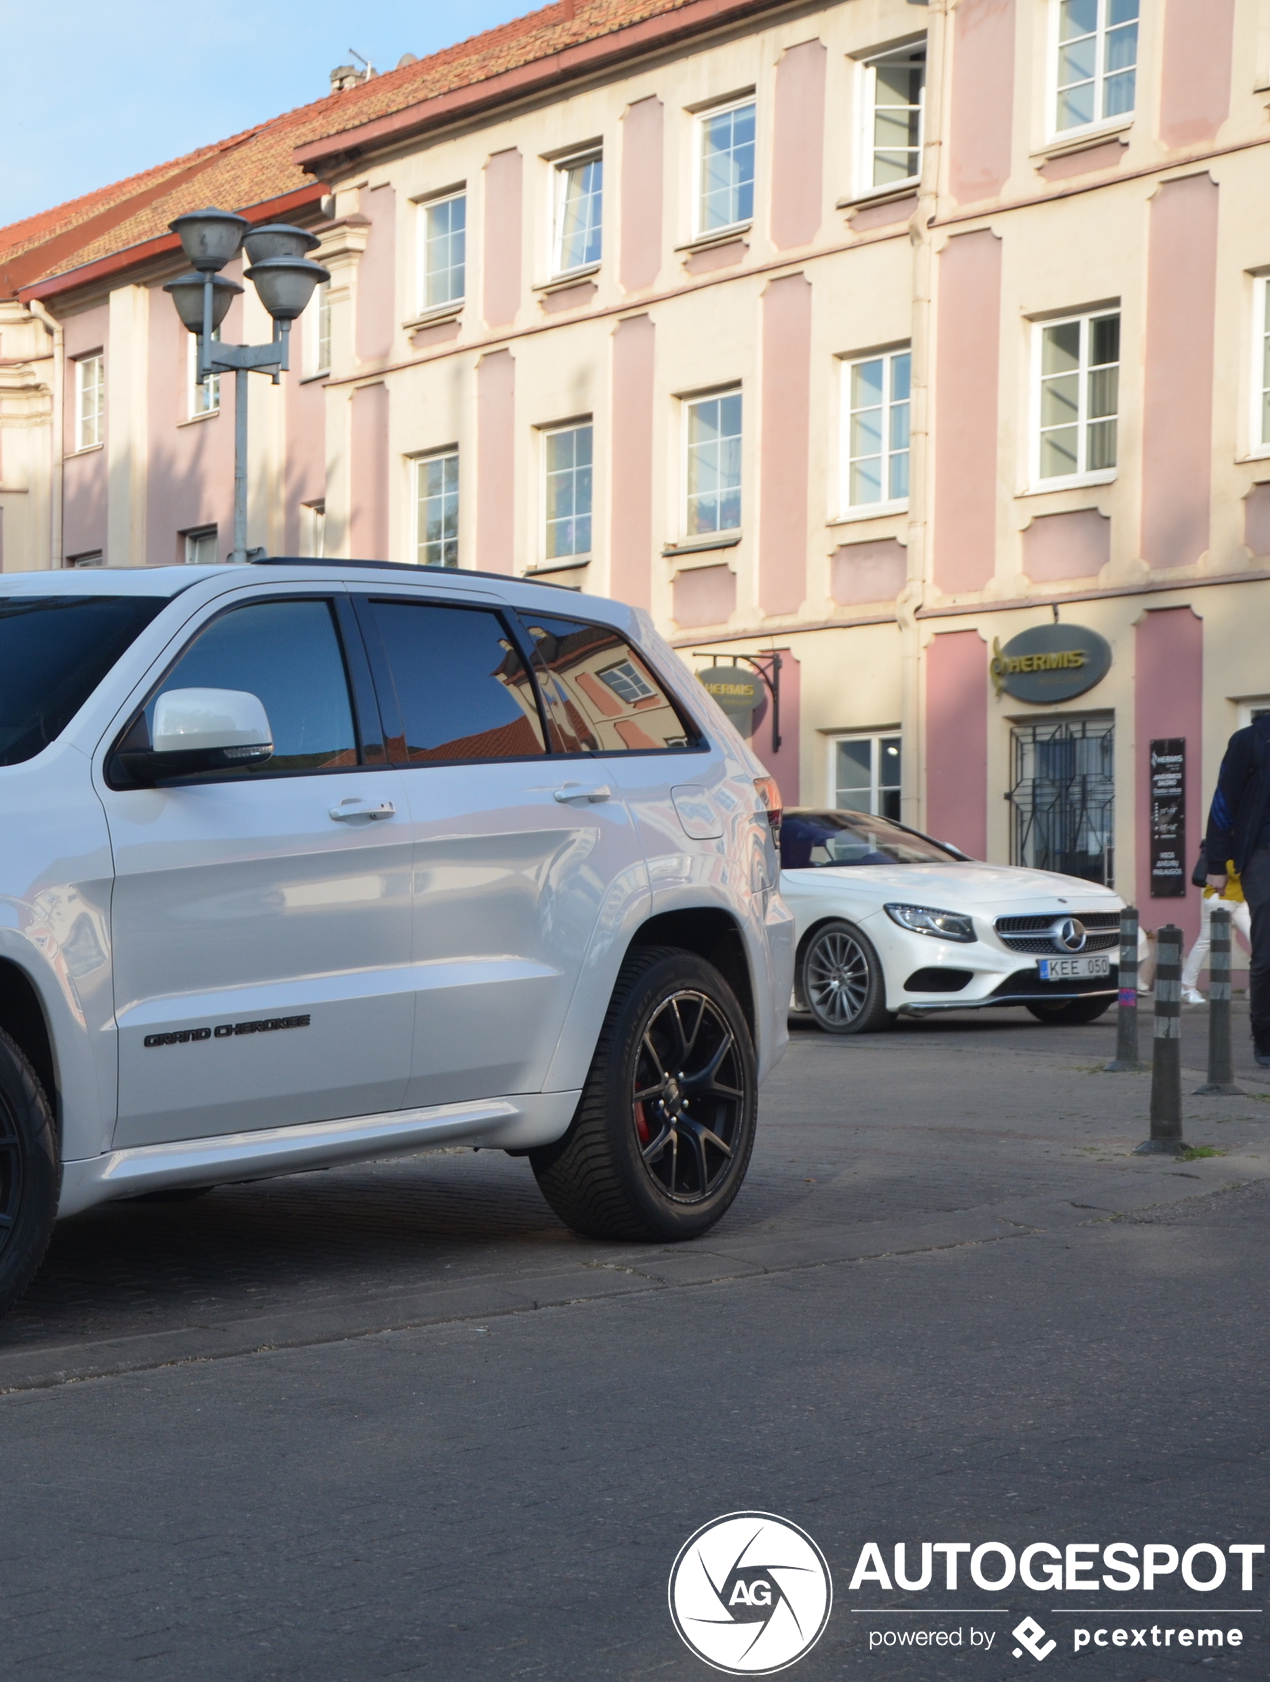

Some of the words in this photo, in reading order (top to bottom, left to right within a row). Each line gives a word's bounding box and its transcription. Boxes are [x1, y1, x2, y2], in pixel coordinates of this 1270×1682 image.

[1010, 650, 1085, 673] HERMIS
[705, 683, 755, 696] HERMIS
[1050, 961, 1080, 975] KEE
[1088, 959, 1108, 974] 050
[144, 1027, 211, 1047] GRAND
[214, 1014, 311, 1038] CHEROKEE
